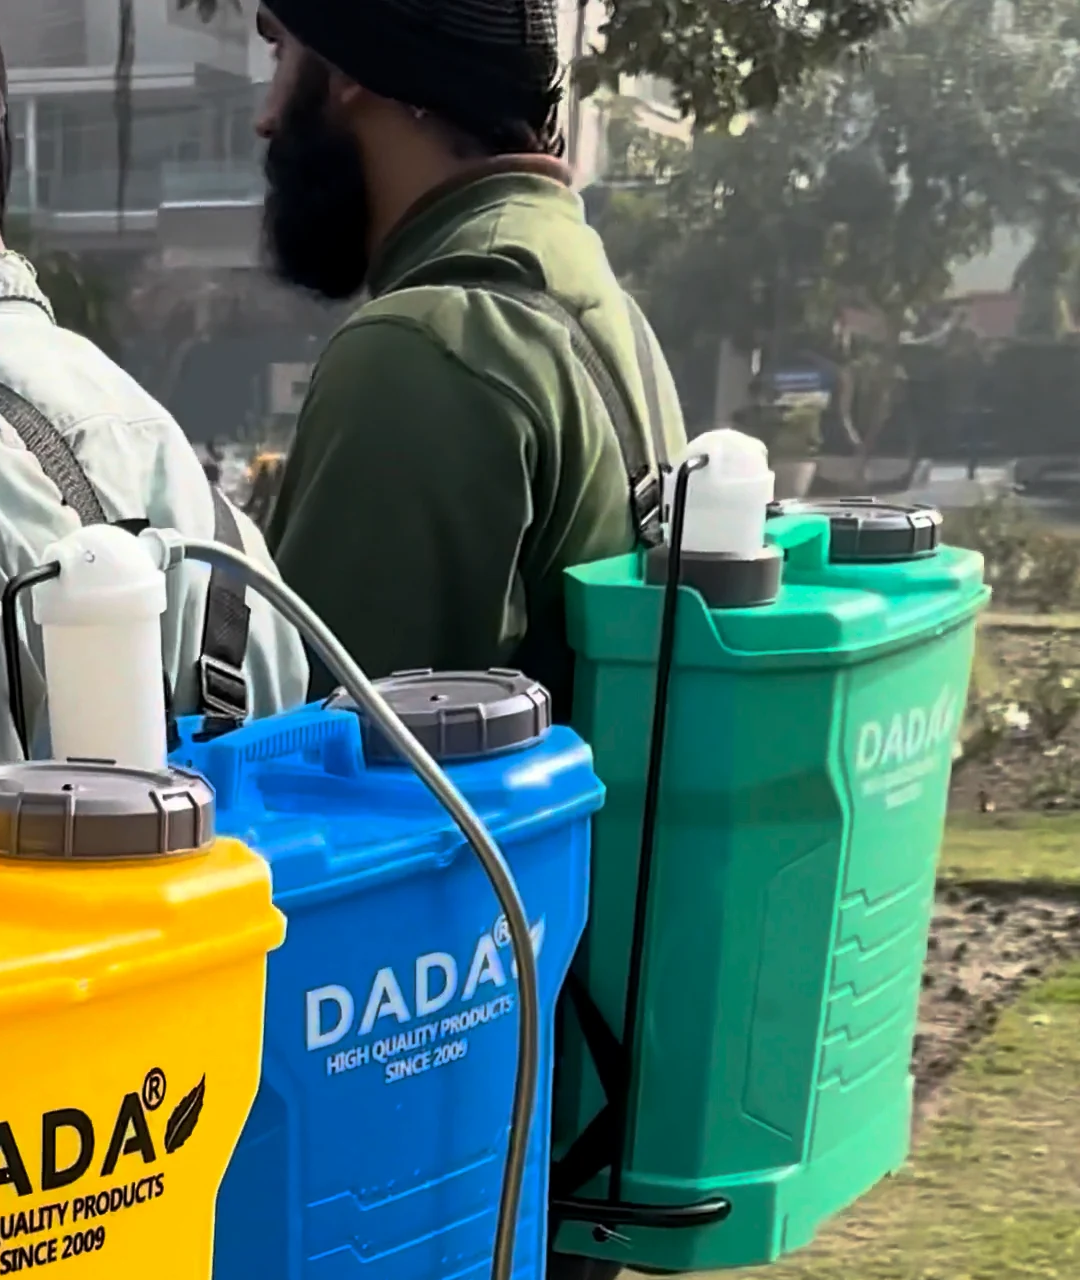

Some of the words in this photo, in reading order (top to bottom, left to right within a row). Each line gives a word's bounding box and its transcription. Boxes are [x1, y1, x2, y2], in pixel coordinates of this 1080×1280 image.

[327, 1045, 369, 1076] HIGH
[372, 1025, 438, 1063] QUALITY
[440, 993, 514, 1035] PRODUCTS
[385, 1055, 431, 1084] SINCE
[433, 1039, 468, 1065] 2009
[73, 1173, 164, 1222] PRODUCTS
[0, 1238, 57, 1275] SINCE
[61, 1226, 106, 1260] 2009
